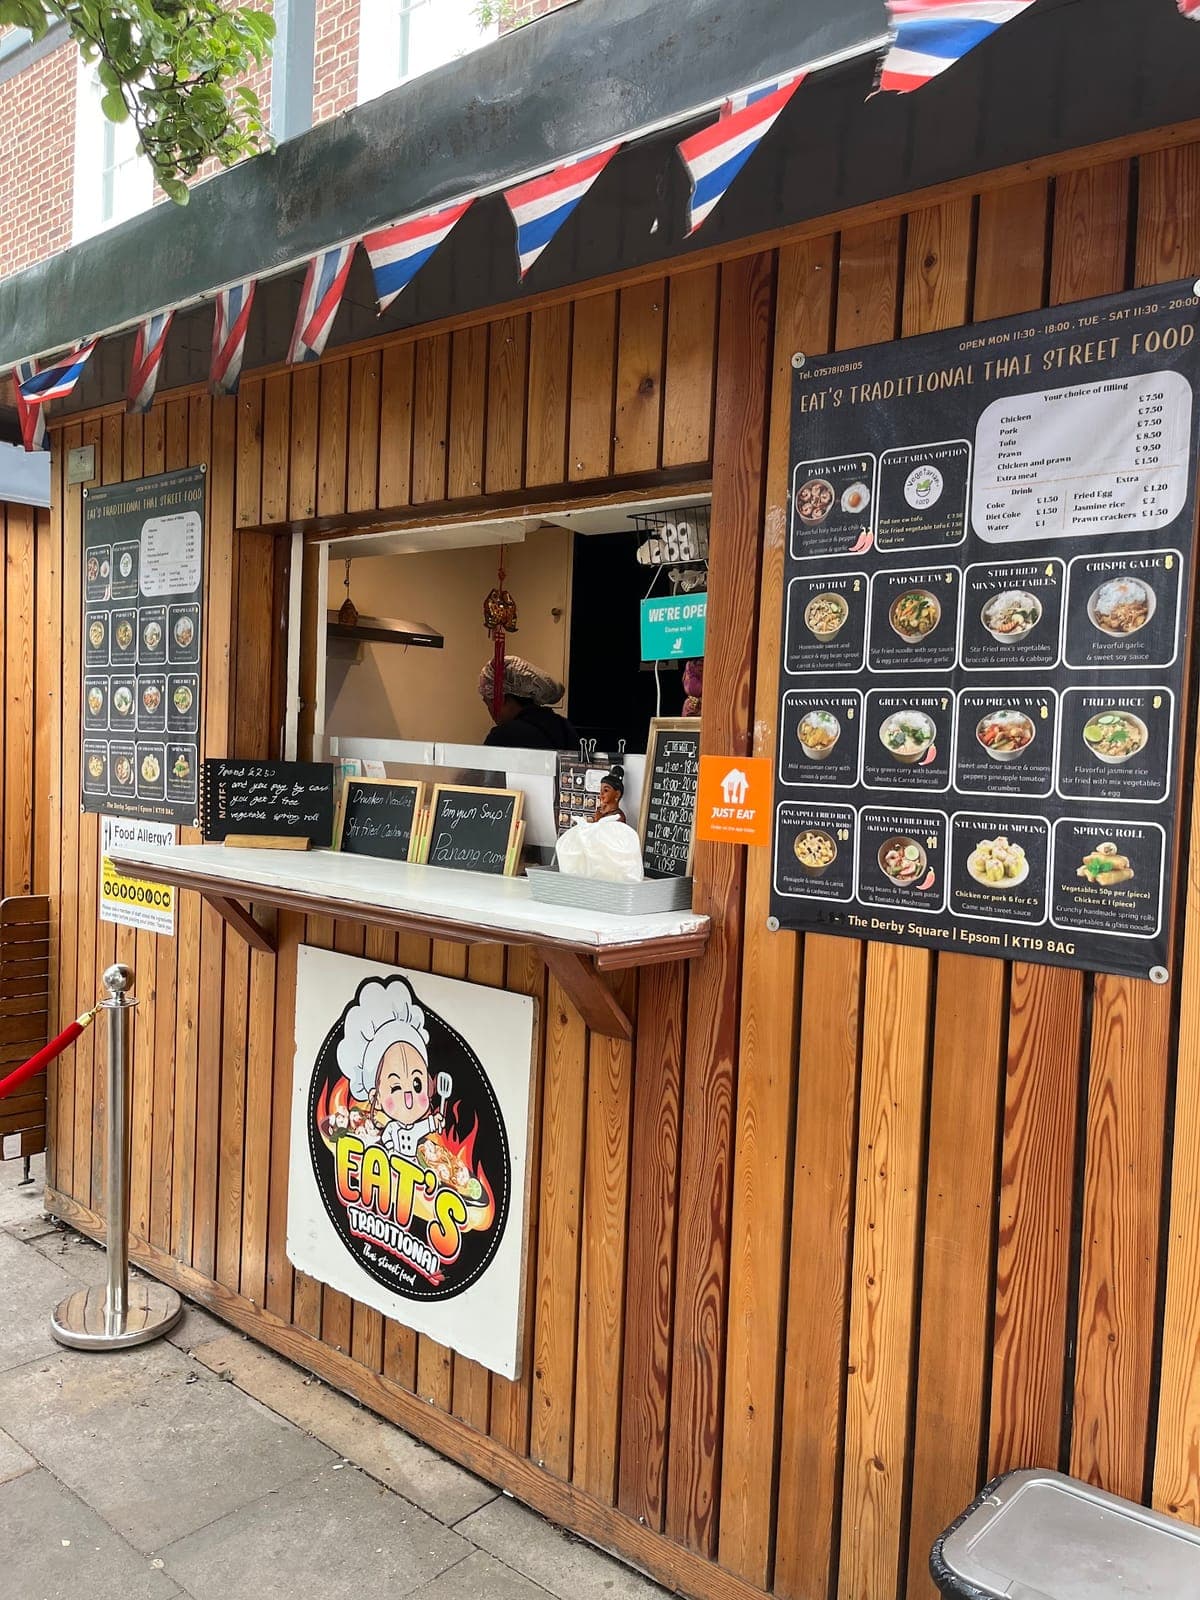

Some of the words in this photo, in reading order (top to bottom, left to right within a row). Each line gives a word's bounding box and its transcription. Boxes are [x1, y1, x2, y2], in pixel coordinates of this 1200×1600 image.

[959, 336, 985, 350] OPEN
[988, 334, 1010, 346] MON
[1013, 329, 1035, 341] 11:30
[1045, 322, 1070, 334] 18:00
[1078, 316, 1098, 328] TUE
[1109, 309, 1130, 321] SAT
[1134, 304, 1158, 316] 11:30
[1169, 297, 1199, 309] 20:00
[801, 388, 843, 413] EAT'S
[850, 365, 973, 405] TRADITIONAL
[984, 354, 1032, 381] THAI
[1043, 337, 1120, 371] STREET
[1132, 324, 1195, 355] FOOD
[799, 370, 812, 380] Tel.
[1044, 393, 1063, 402] Your
[1064, 389, 1091, 399] choice
[1093, 386, 1101, 394] of
[1103, 383, 1128, 392] filling
[1001, 414, 1032, 424] Chicken
[1000, 427, 1018, 435] Pork
[999, 439, 1016, 447] Tofu
[882, 453, 934, 465] VEGETARIAN
[936, 449, 968, 458] OPTION
[998, 450, 1022, 459] Prawn
[997, 462, 1028, 471] Chicken
[1030, 459, 1044, 467] and
[1046, 455, 1071, 466] prawn
[808, 467, 824, 476] PAD
[838, 464, 858, 473] POW
[997, 474, 1017, 482] Extra
[1019, 472, 1037, 480] meat
[1116, 476, 1139, 484] Extra
[1074, 491, 1095, 500] Fried
[1097, 490, 1112, 498] Egg
[986, 502, 1005, 510] Coke
[1073, 503, 1107, 512] Jasmine
[986, 513, 1000, 521] Diet
[1002, 511, 1021, 519] Coke
[1072, 516, 1098, 524] Prawn
[1100, 512, 1136, 521] crackers
[1130, 559, 1162, 569] GALIC
[1011, 567, 1037, 575] FRIED
[889, 575, 908, 585] PAD
[998, 578, 1057, 588] VEGETABLES
[809, 582, 825, 590] PAD
[827, 581, 846, 589] THAI
[649, 607, 680, 622] WE'RE
[1017, 645, 1050, 653] vegetables
[1125, 642, 1144, 650] garlic
[1026, 655, 1052, 664] cabbage
[910, 698, 939, 706] CURRY
[964, 698, 984, 706] PAD
[1123, 779, 1160, 787] vegetables
[219, 782, 227, 818] NOTES
[711, 807, 735, 818] JUST
[736, 809, 755, 819] EAT
[955, 821, 997, 830] STEAMED
[999, 824, 1046, 834] DUMPLING
[1073, 826, 1112, 836] SPRING
[1116, 829, 1145, 838] ROLL
[115, 826, 134, 839] Food
[138, 829, 172, 846] Allergy?
[837, 829, 848, 840] 10
[927, 837, 937, 848] 11
[956, 890, 981, 898] Chicken
[1062, 885, 1097, 894] Vegetables
[1100, 888, 1112, 897] 50p
[1114, 890, 1126, 898] per
[1128, 890, 1150, 899] (piece)
[1074, 896, 1100, 905] Chicken
[1113, 899, 1135, 908] (piece)
[1056, 905, 1081, 915] Crunchy
[1084, 908, 1117, 917] handmade
[1119, 911, 1138, 920] spring
[1070, 917, 1103, 927] vegetables
[848, 916, 869, 927] The
[872, 919, 903, 934] Derby
[908, 924, 949, 940] Square
[961, 930, 1000, 946] Epsom
[1012, 936, 1043, 950] KT19
[1047, 942, 1075, 954] 8AG
[336, 1136, 467, 1257] EAT'S
[349, 1209, 438, 1272] TRADITIONAL
[378, 1254, 401, 1276] street
[400, 1269, 417, 1287] food
